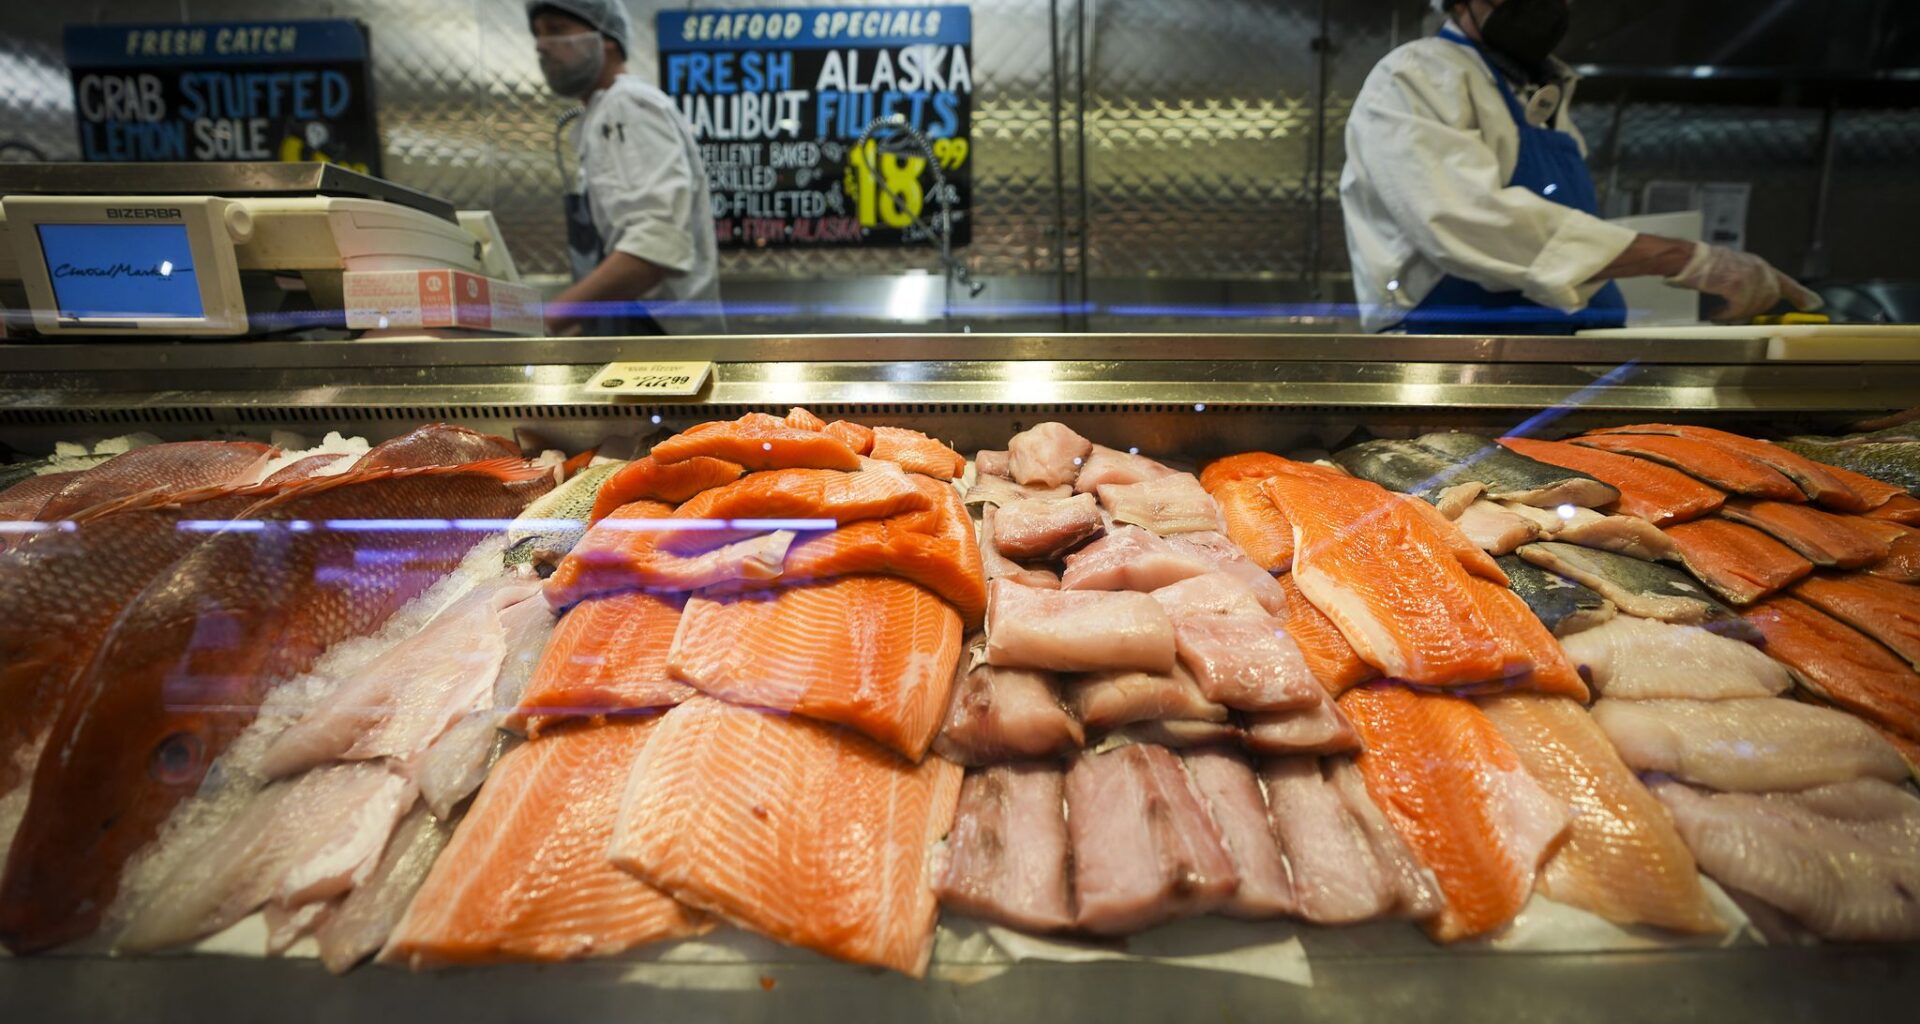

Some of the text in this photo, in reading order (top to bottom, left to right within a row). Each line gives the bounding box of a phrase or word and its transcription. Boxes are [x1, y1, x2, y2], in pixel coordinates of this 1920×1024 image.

[126, 26, 298, 55] FRESH CATCH
[682, 10, 942, 41] SEAFOOD SPECIALS
[667, 44, 972, 95] FRESH ALASKA
[79, 71, 350, 122] CRAB STUFFED
[816, 90, 960, 140] FILLETS
[82, 120, 187, 161] LEMON
[193, 118, 272, 160] SOLE
[701, 142, 821, 168] ELLENT BAKED
[106, 208, 182, 219] BIZERBA
[711, 190, 827, 218] D-FILLETED
[111, 262, 193, 281] Mark
